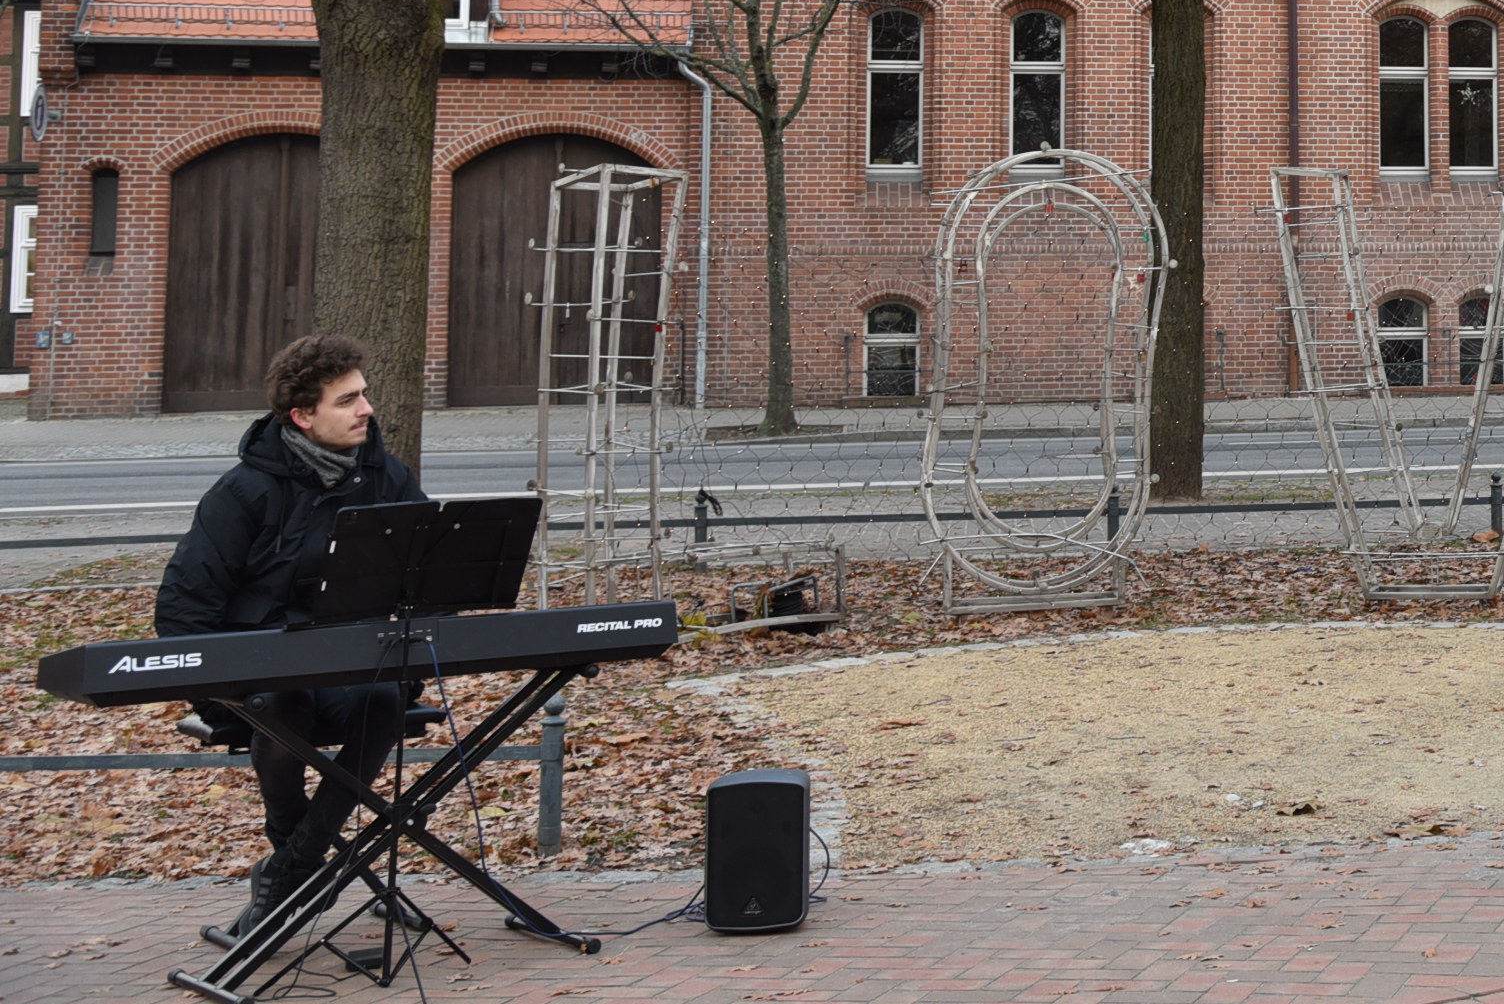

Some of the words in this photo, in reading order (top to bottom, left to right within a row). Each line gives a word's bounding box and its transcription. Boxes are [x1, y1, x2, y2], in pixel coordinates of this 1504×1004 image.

[576, 620, 632, 634] RECITAL
[633, 617, 663, 629] PRO
[108, 652, 203, 674] ALESIS
